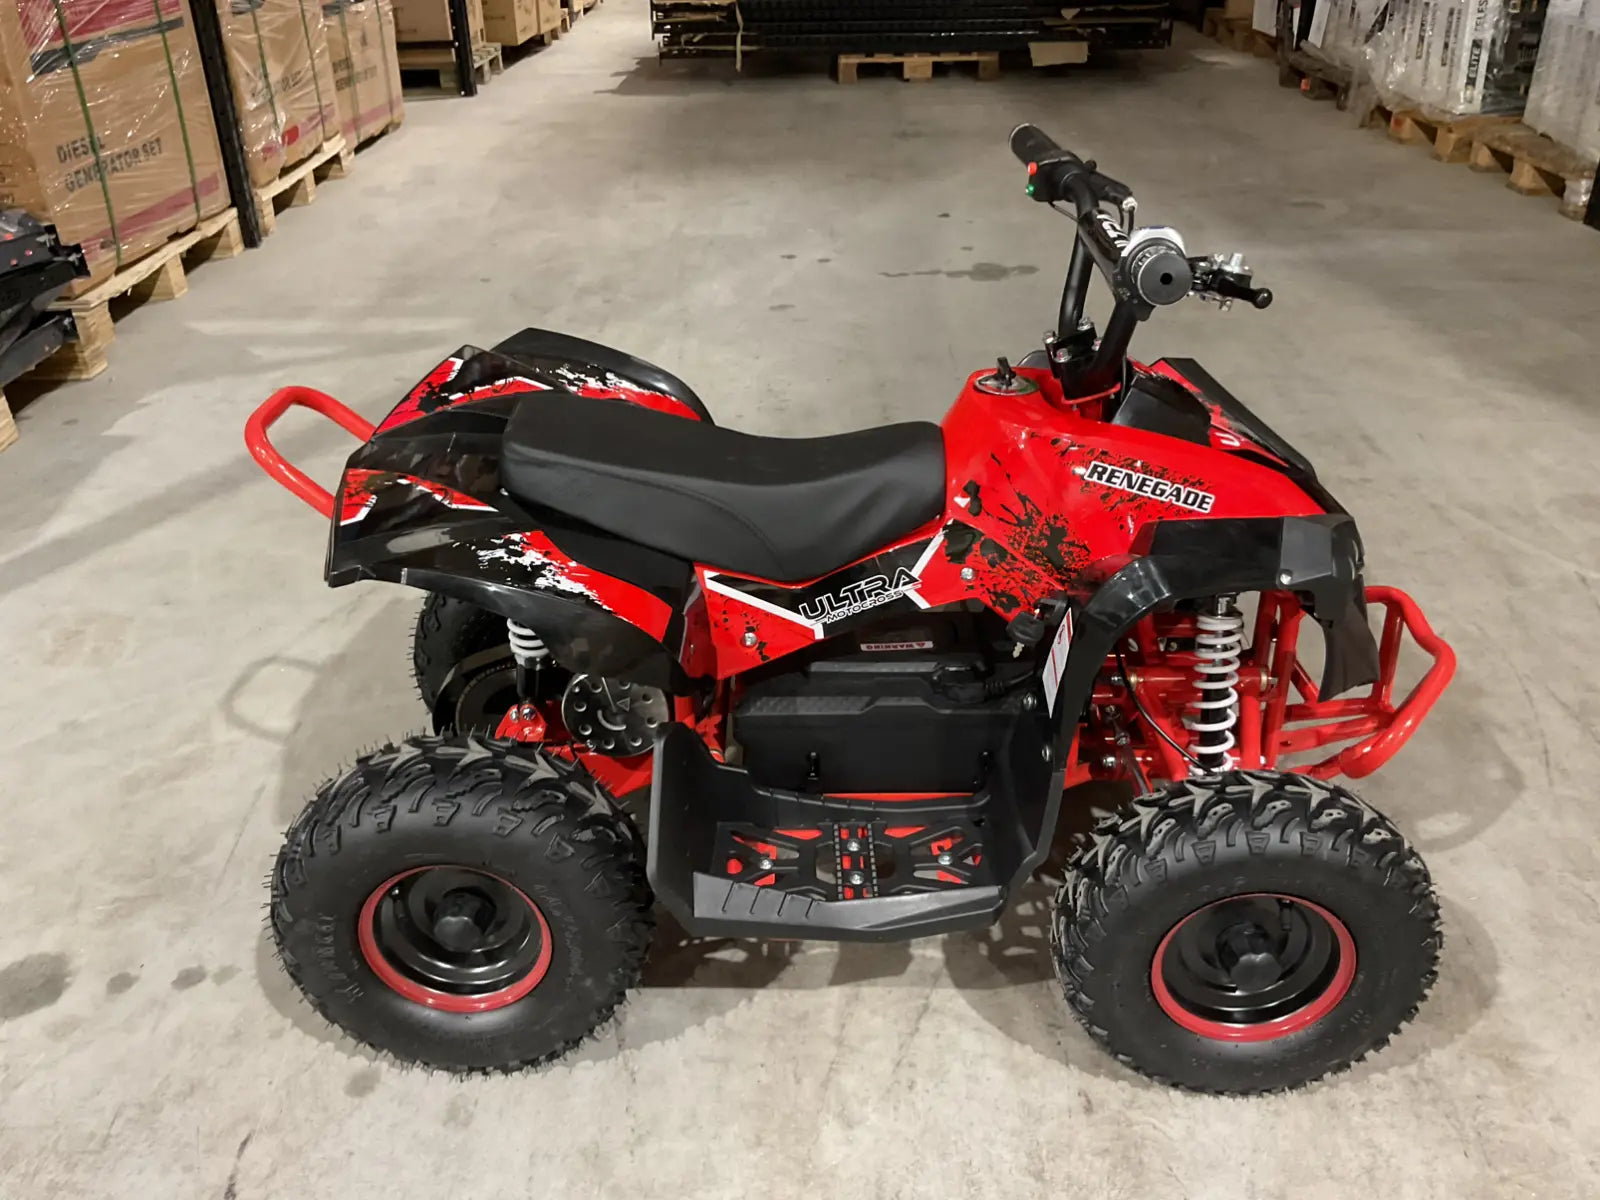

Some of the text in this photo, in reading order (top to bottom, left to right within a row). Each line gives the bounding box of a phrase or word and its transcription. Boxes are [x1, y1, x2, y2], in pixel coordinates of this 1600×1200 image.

[1468, 46, 1481, 78] ELITE
[56, 136, 106, 163] DIESL
[142, 136, 163, 162] SET
[1085, 461, 1214, 513] RENEGADE
[799, 567, 922, 621] ULTRA
[826, 589, 904, 624] MOTOCROSS
